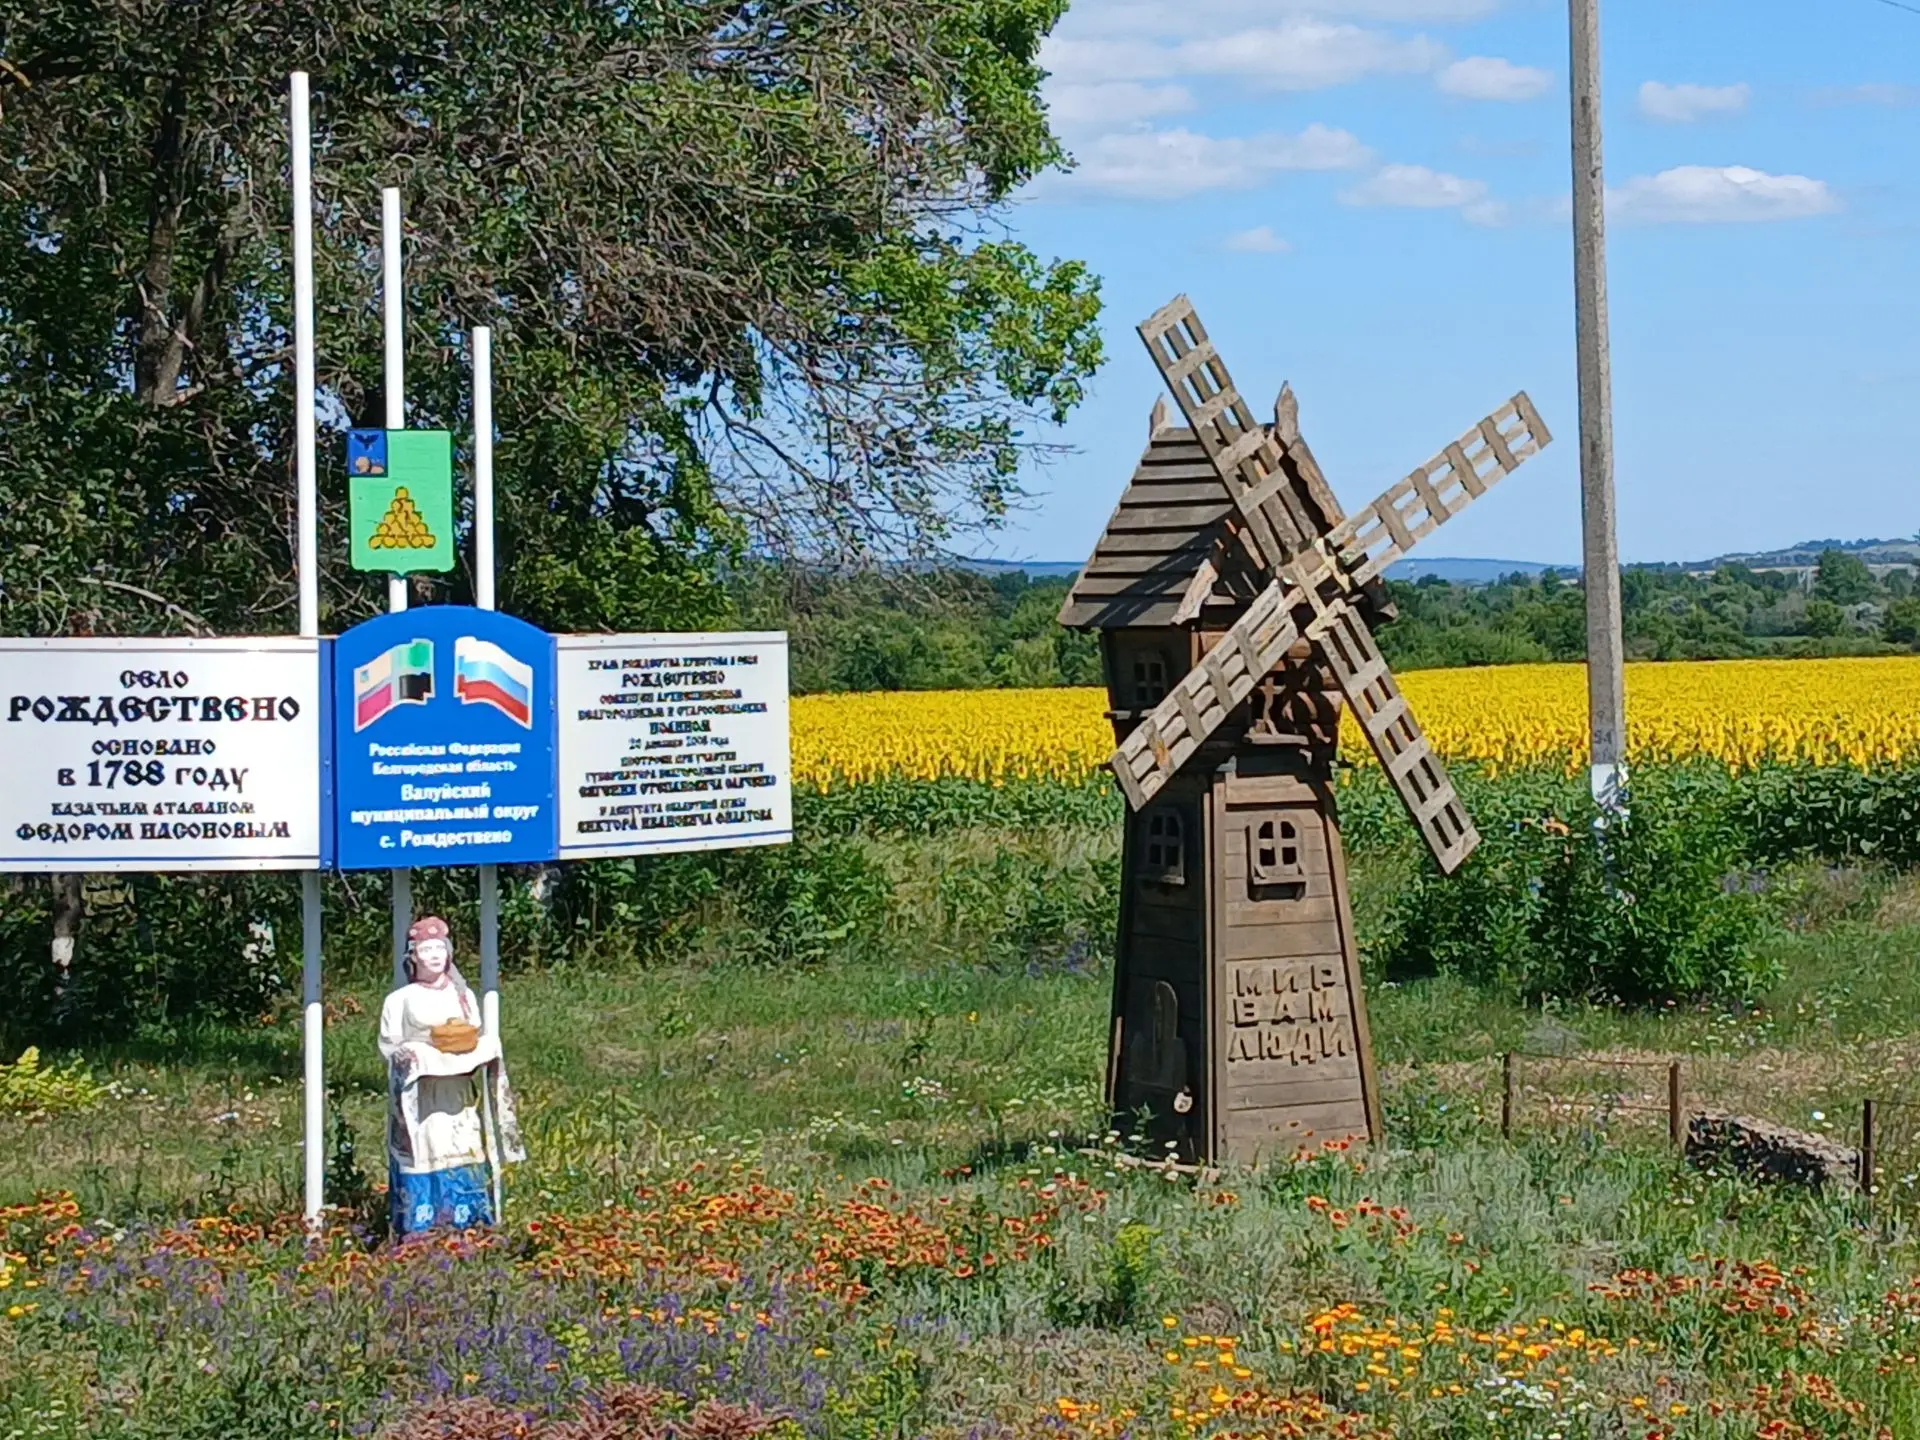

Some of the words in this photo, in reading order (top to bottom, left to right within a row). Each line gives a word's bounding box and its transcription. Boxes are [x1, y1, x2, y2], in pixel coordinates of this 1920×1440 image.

[7, 696, 300, 727] РОЖДЕСТВЕНО
[91, 739, 216, 756] ОСНОВАНО
[369, 742, 446, 757] Российская
[448, 741, 521, 757] Федерация
[86, 760, 165, 789] 1788
[372, 761, 464, 777] Белгородская
[466, 759, 518, 773] область
[401, 782, 491, 802] Валуйский
[350, 804, 489, 825] муниципальный
[493, 805, 539, 820] округ
[16, 822, 133, 843] ФЕДОРОМ
[379, 834, 396, 848] с.
[400, 829, 513, 848] Рождествено
[1235, 965, 1336, 997] МИР
[1232, 991, 1335, 1028] ВАМ
[1227, 1024, 1355, 1066] ЛЮДИ
